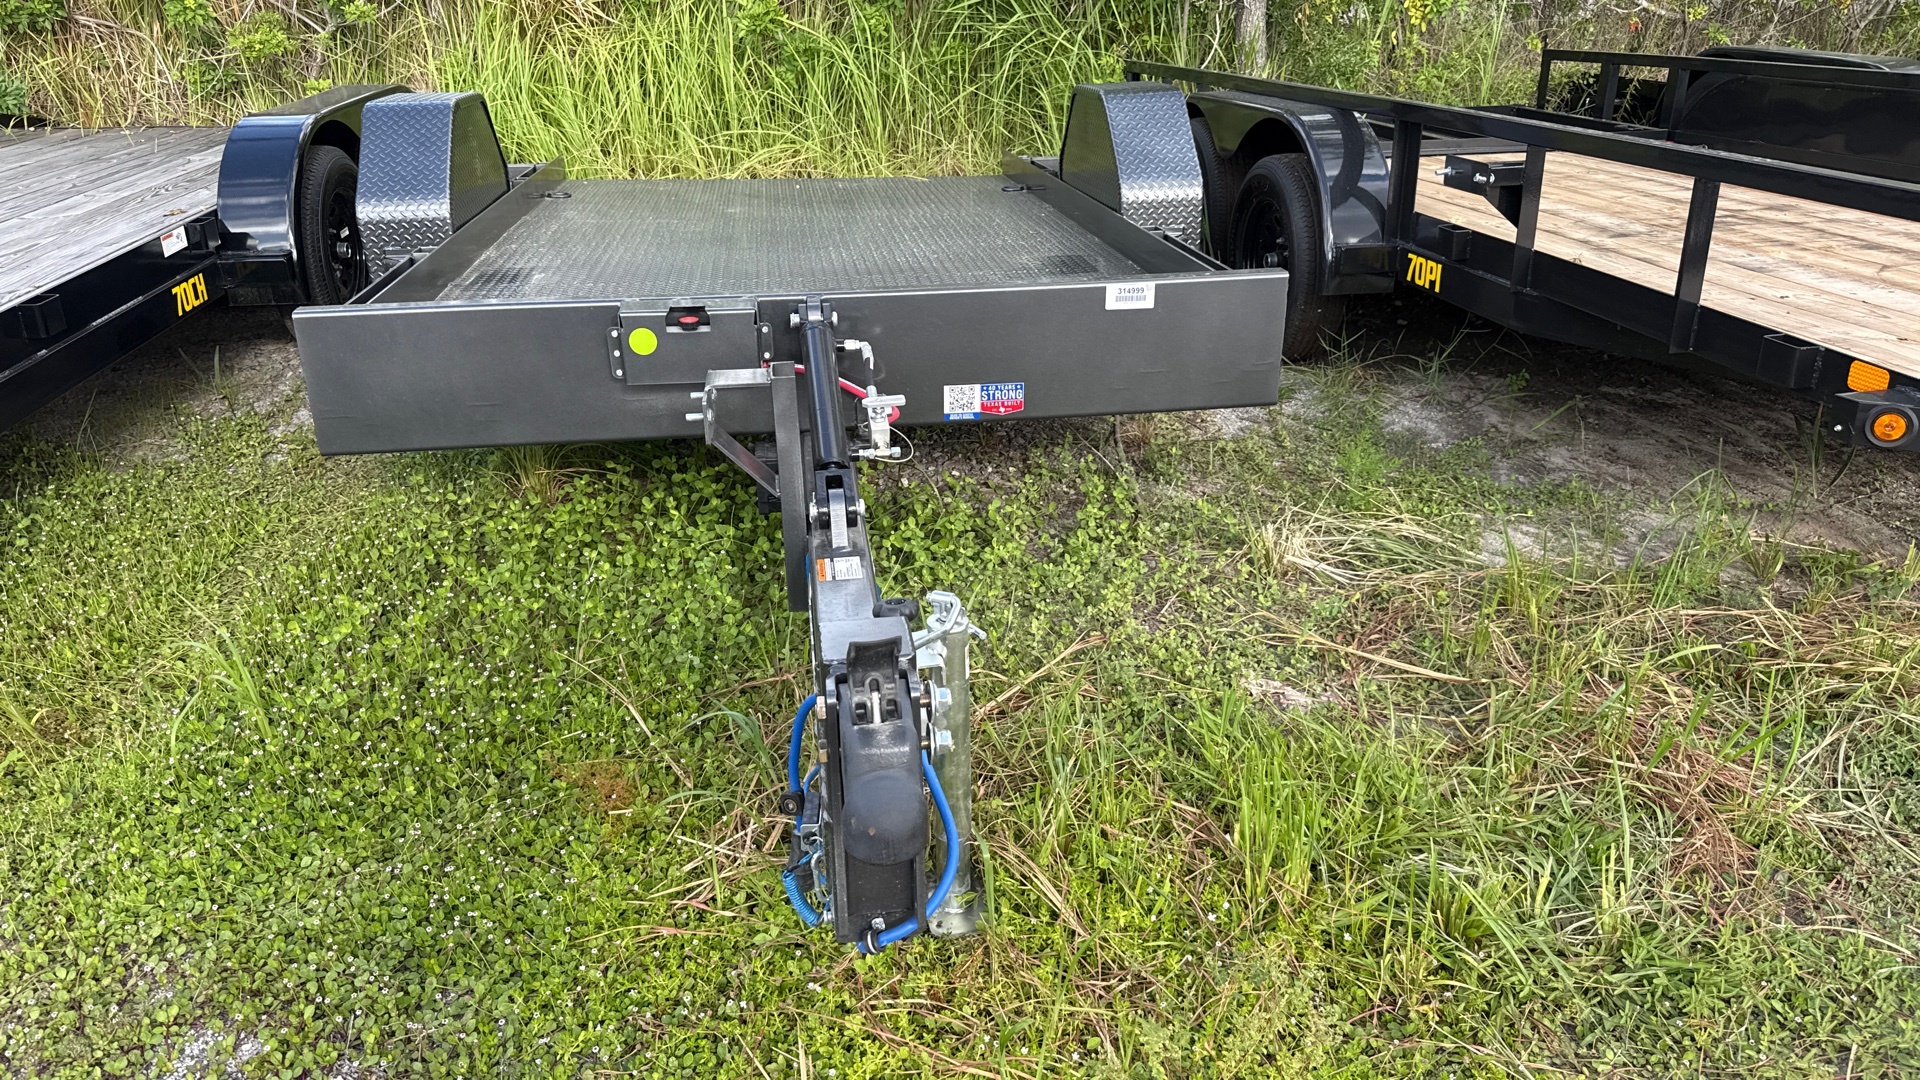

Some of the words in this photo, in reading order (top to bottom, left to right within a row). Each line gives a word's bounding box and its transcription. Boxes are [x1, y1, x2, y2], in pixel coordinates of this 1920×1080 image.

[1406, 253, 1443, 294] 70PI
[171, 272, 209, 317] 70CH
[1117, 287, 1145, 295] 314999
[981, 389, 1023, 401] STRONG
